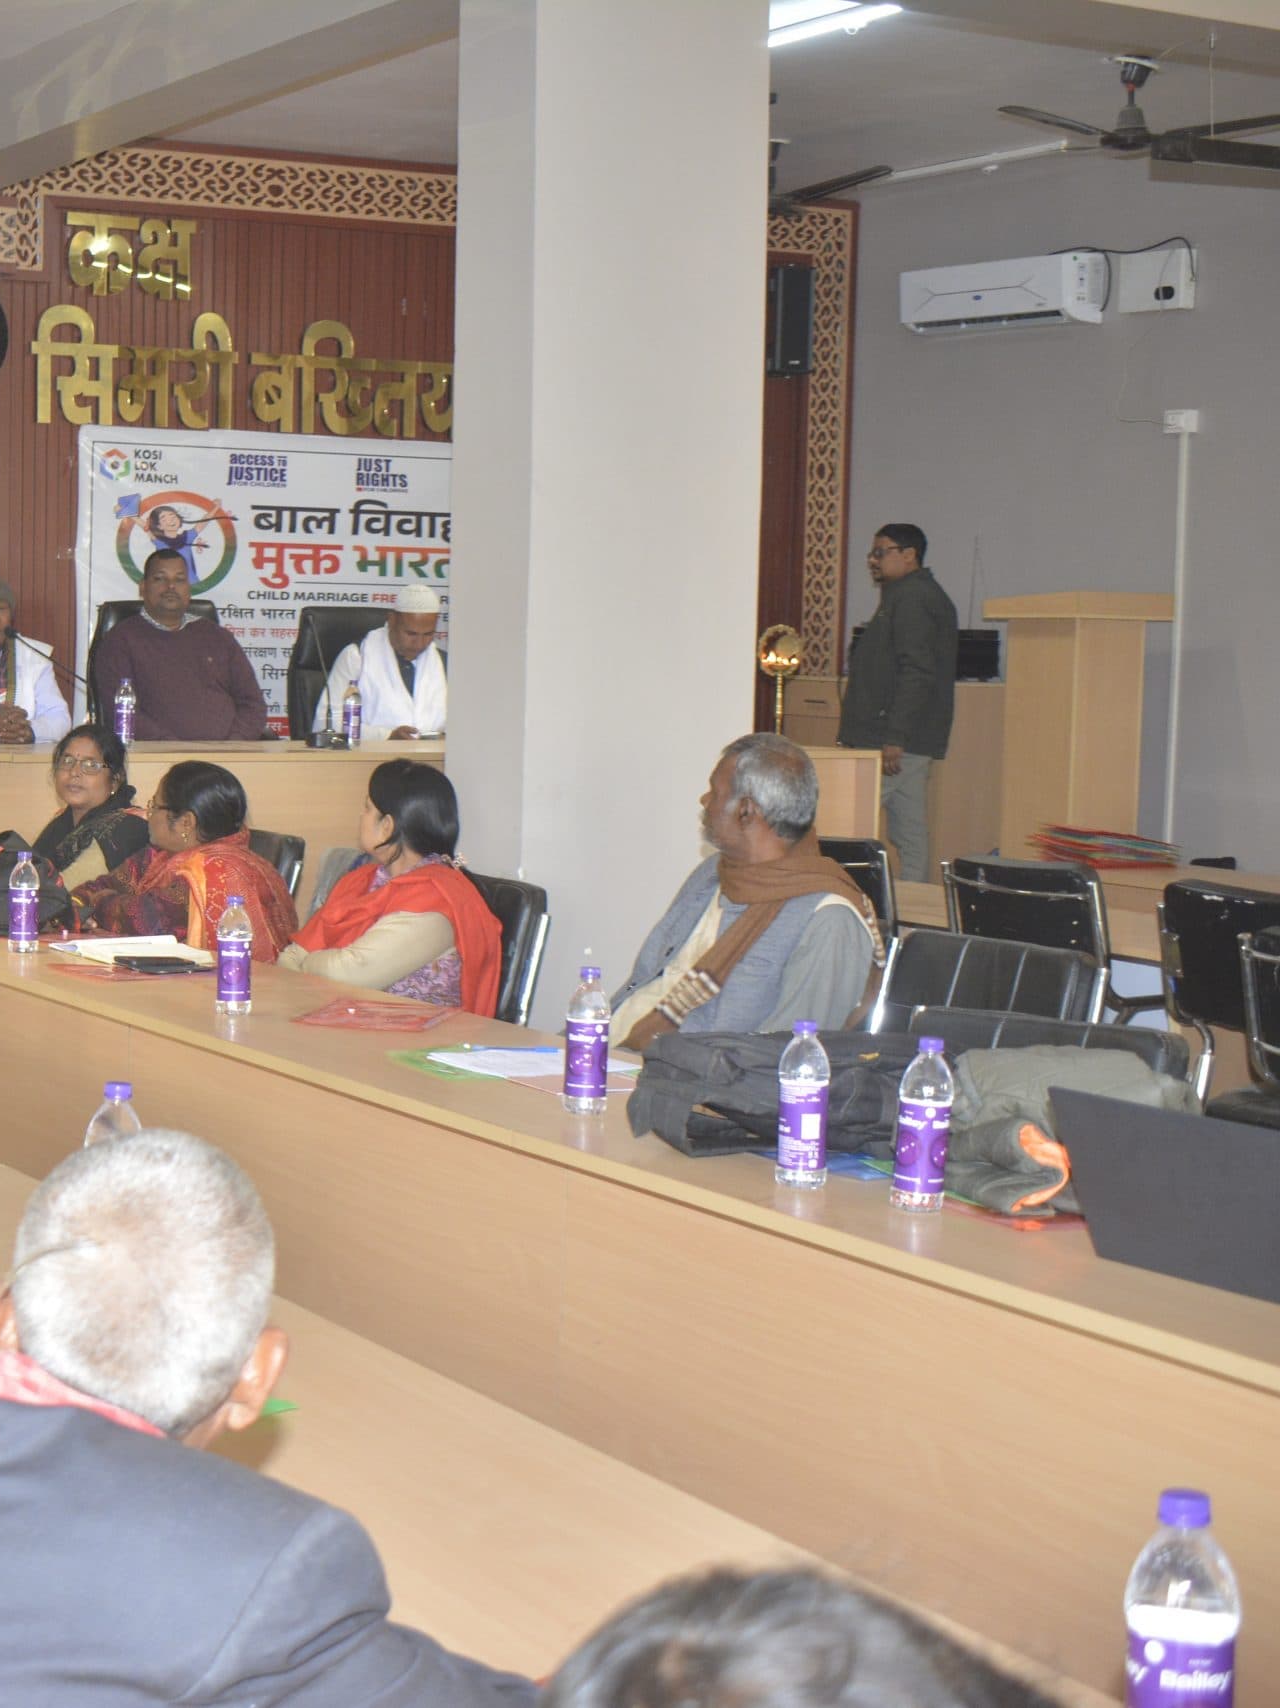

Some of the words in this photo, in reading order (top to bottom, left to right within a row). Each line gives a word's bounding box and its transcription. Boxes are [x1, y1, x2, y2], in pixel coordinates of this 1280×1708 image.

[65, 211, 198, 300] कक्ष
[31, 304, 239, 430] सिमरी
[134, 448, 162, 461] KOSI
[134, 461, 157, 472] LOK
[356, 457, 392, 472] JUST
[134, 472, 179, 484] MANCH
[356, 472, 409, 488] RIGHTS
[251, 504, 340, 535] बाल
[248, 541, 344, 589] मुक्त
[247, 590, 290, 601] CHILD
[293, 591, 369, 603] MARRIAGE
[260, 607, 297, 619] भारत
